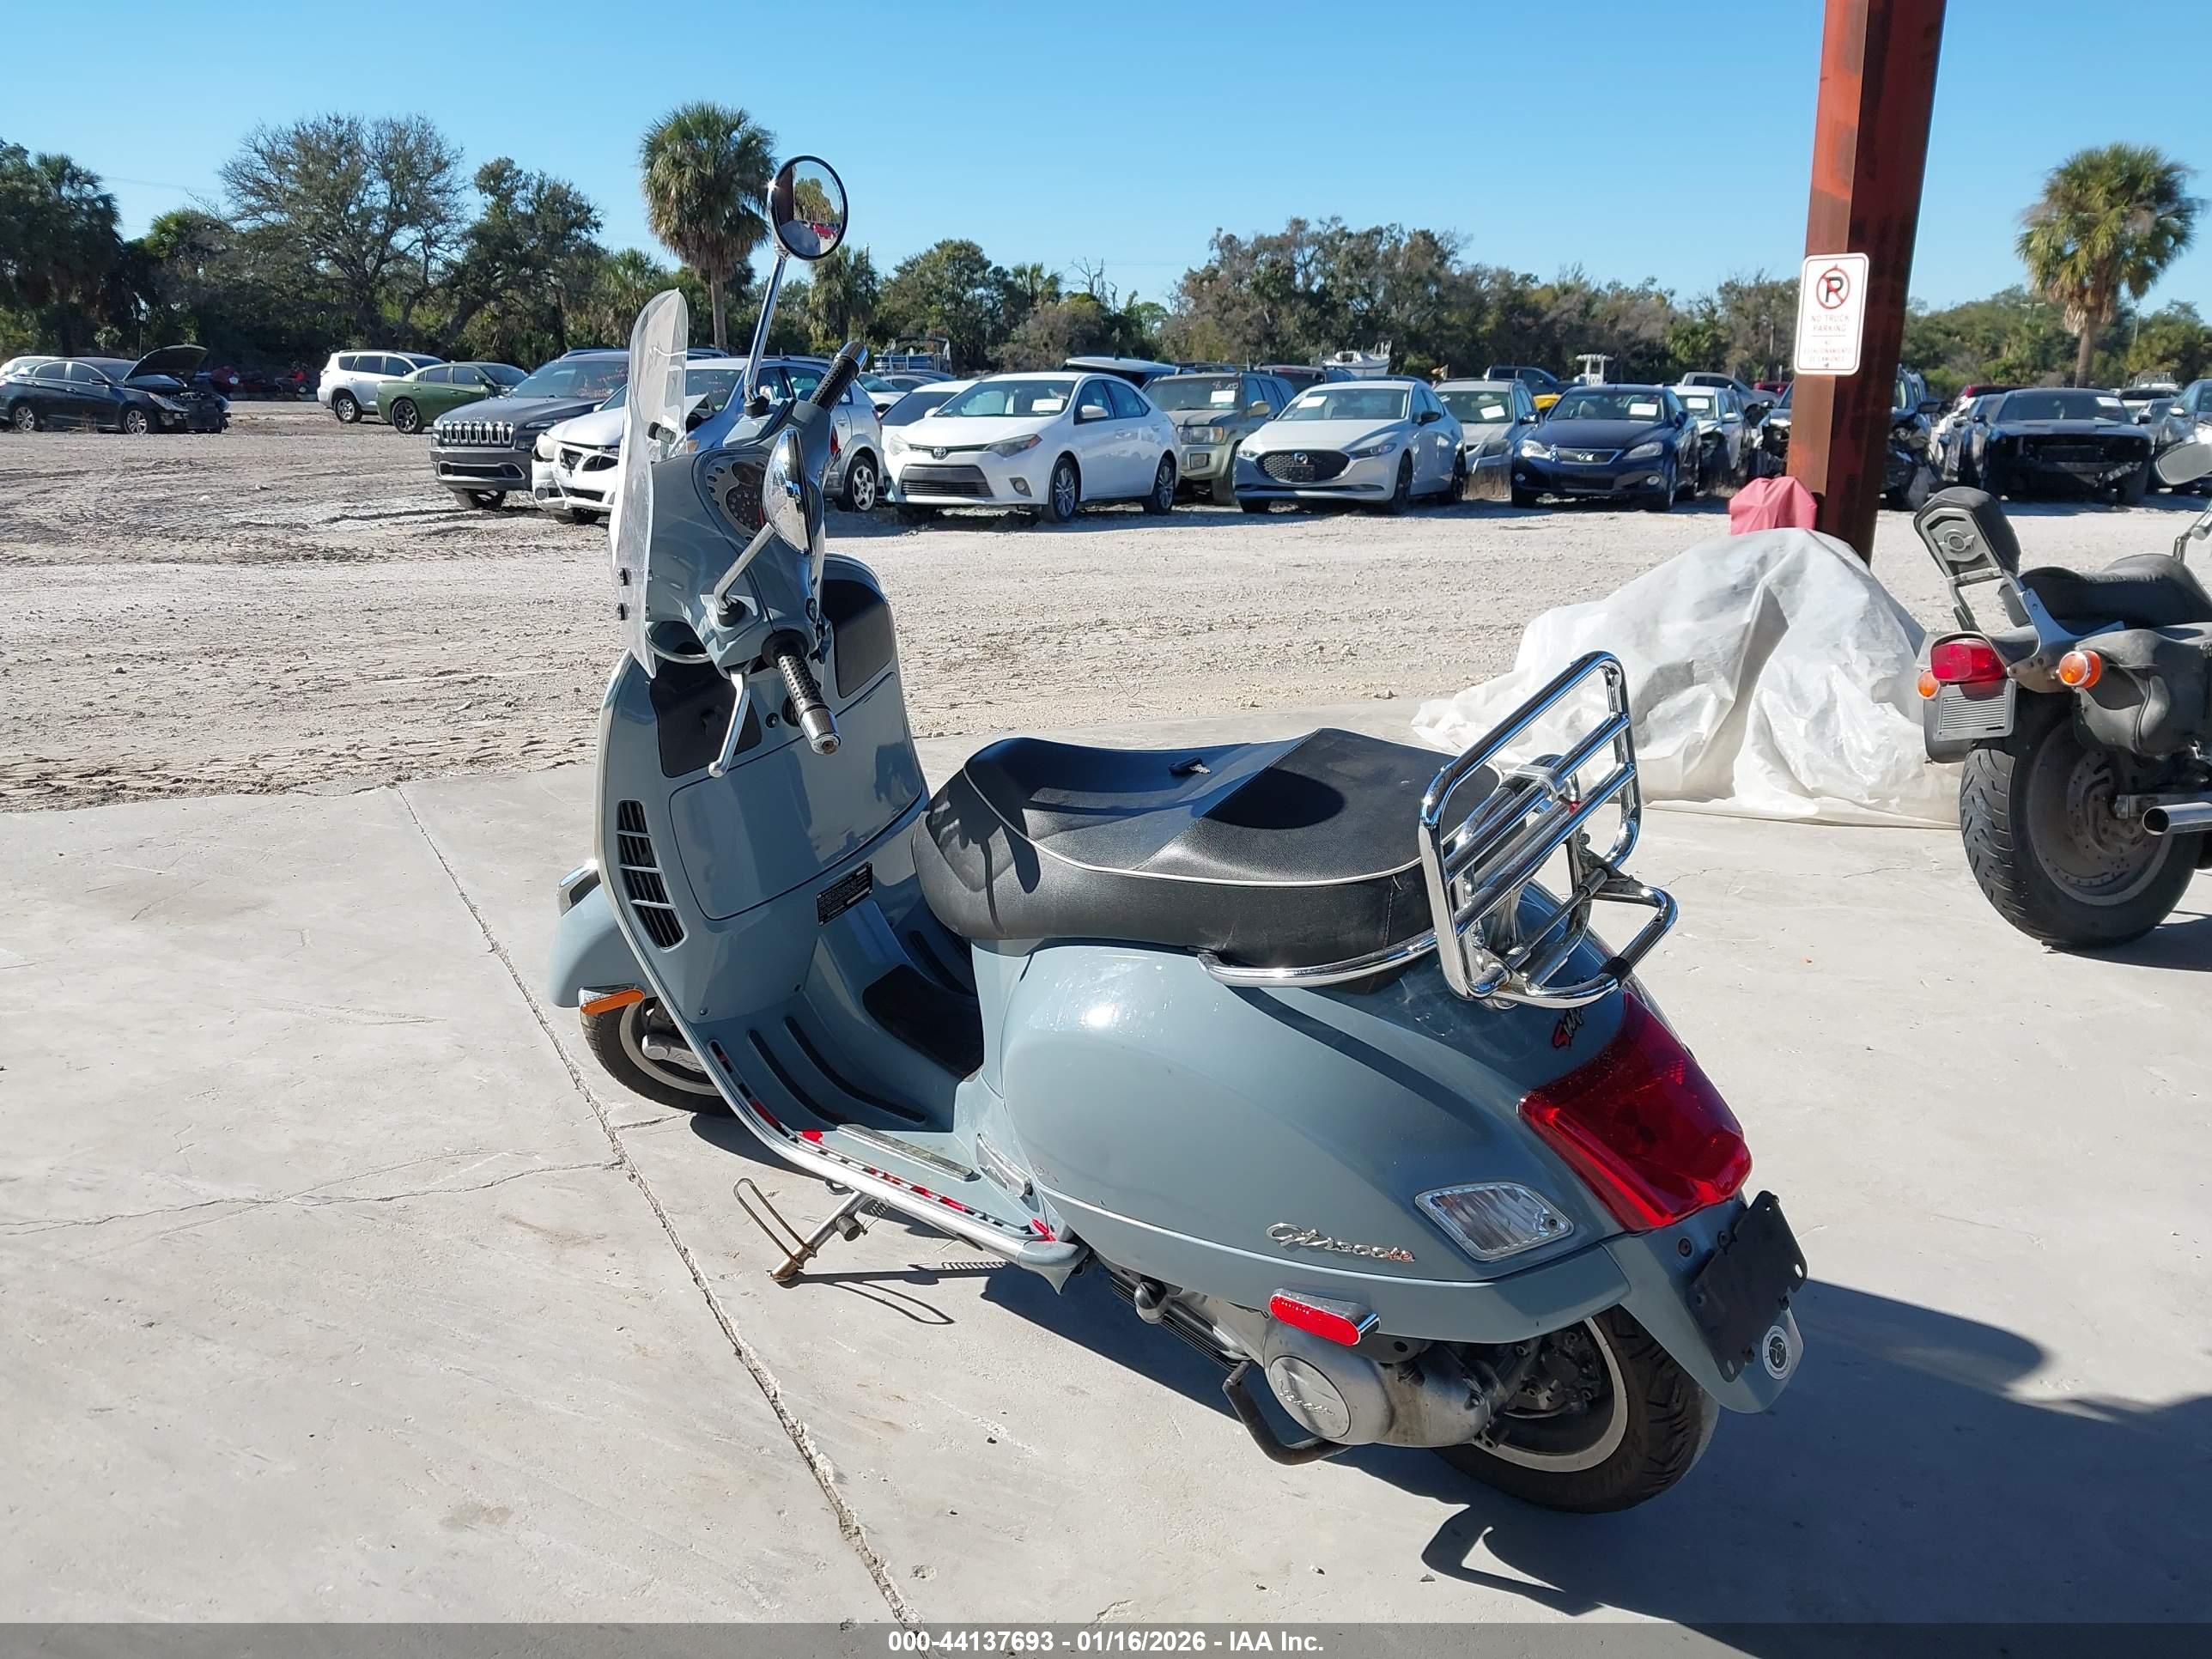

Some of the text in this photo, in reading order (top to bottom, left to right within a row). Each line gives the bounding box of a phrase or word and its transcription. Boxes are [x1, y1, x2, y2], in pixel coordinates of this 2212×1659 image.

[1811, 313, 1850, 323] NO TRUCK
[1813, 324, 1846, 332] PARKING
